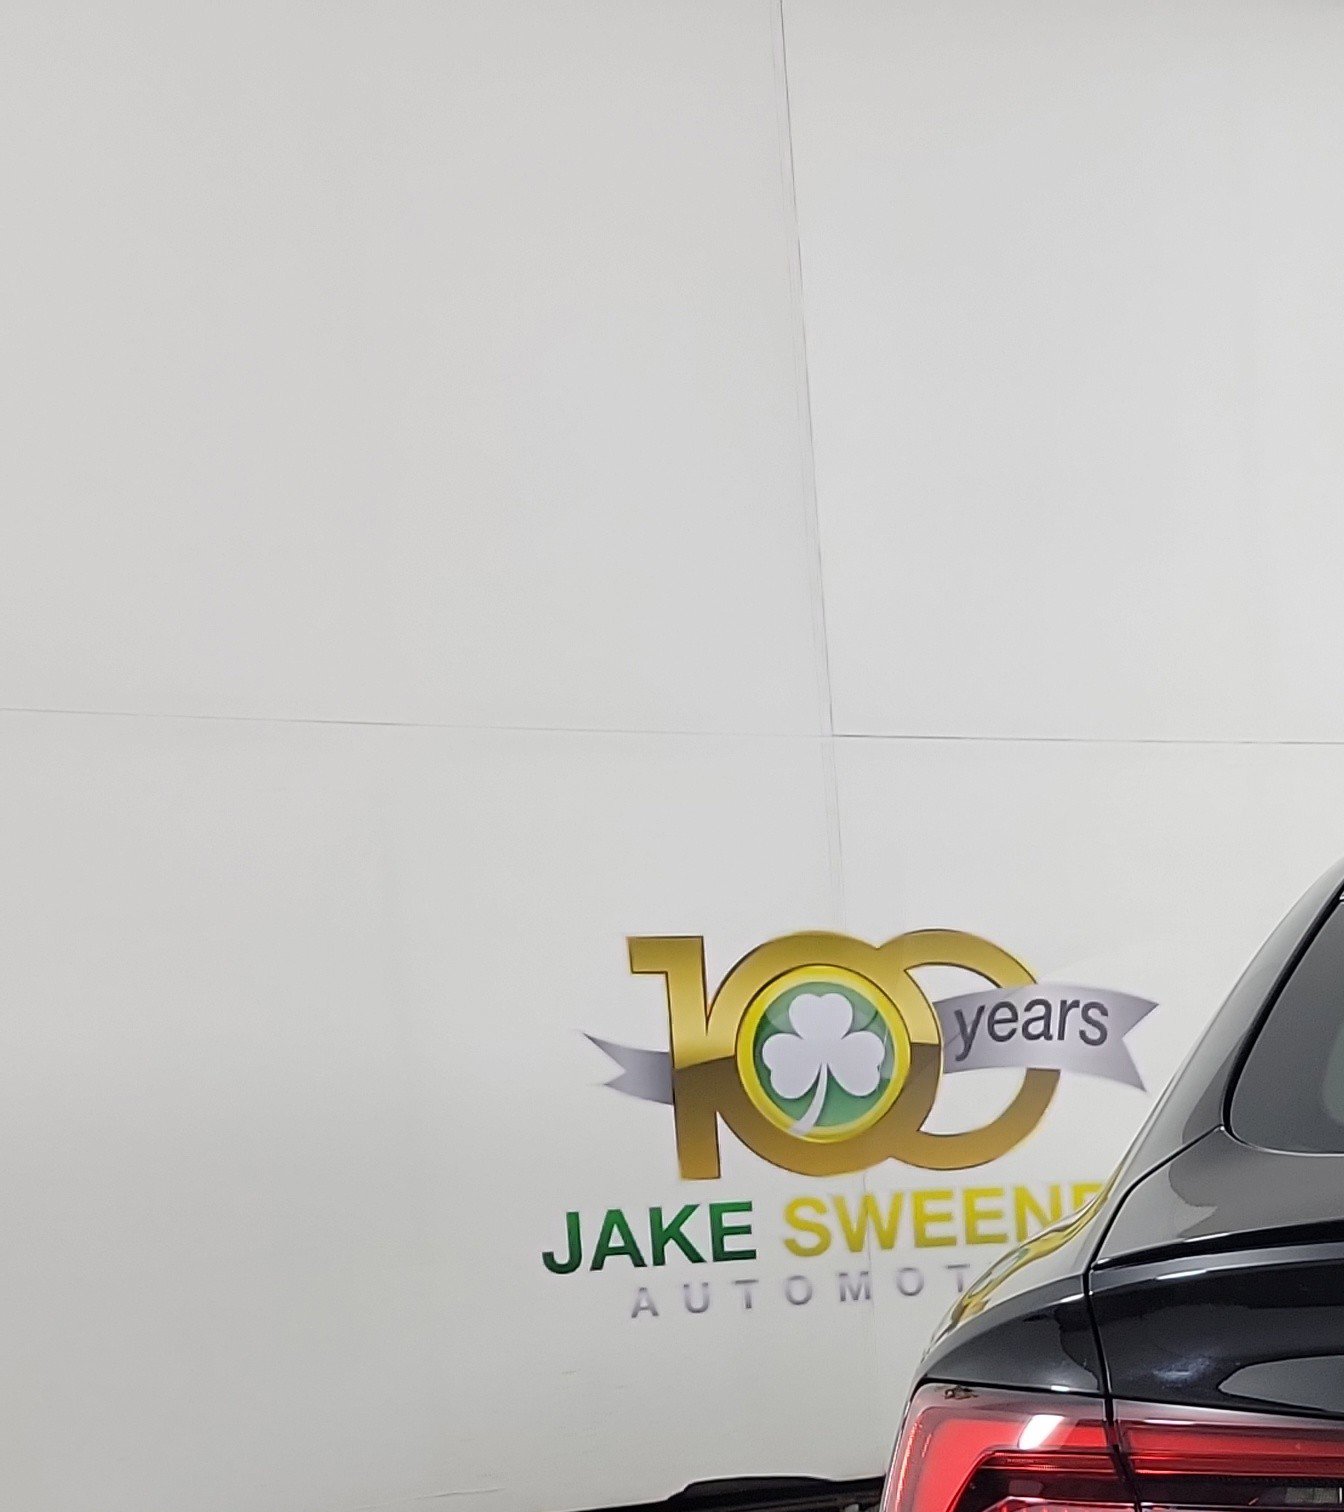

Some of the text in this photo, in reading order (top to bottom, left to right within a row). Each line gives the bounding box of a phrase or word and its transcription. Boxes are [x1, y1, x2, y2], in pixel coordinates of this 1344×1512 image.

[627, 928, 1062, 1179] 100
[954, 997, 1109, 1060] years
[541, 1180, 1104, 1275] JAKE SWEEN
[630, 1263, 971, 1319] AUTOMOT
